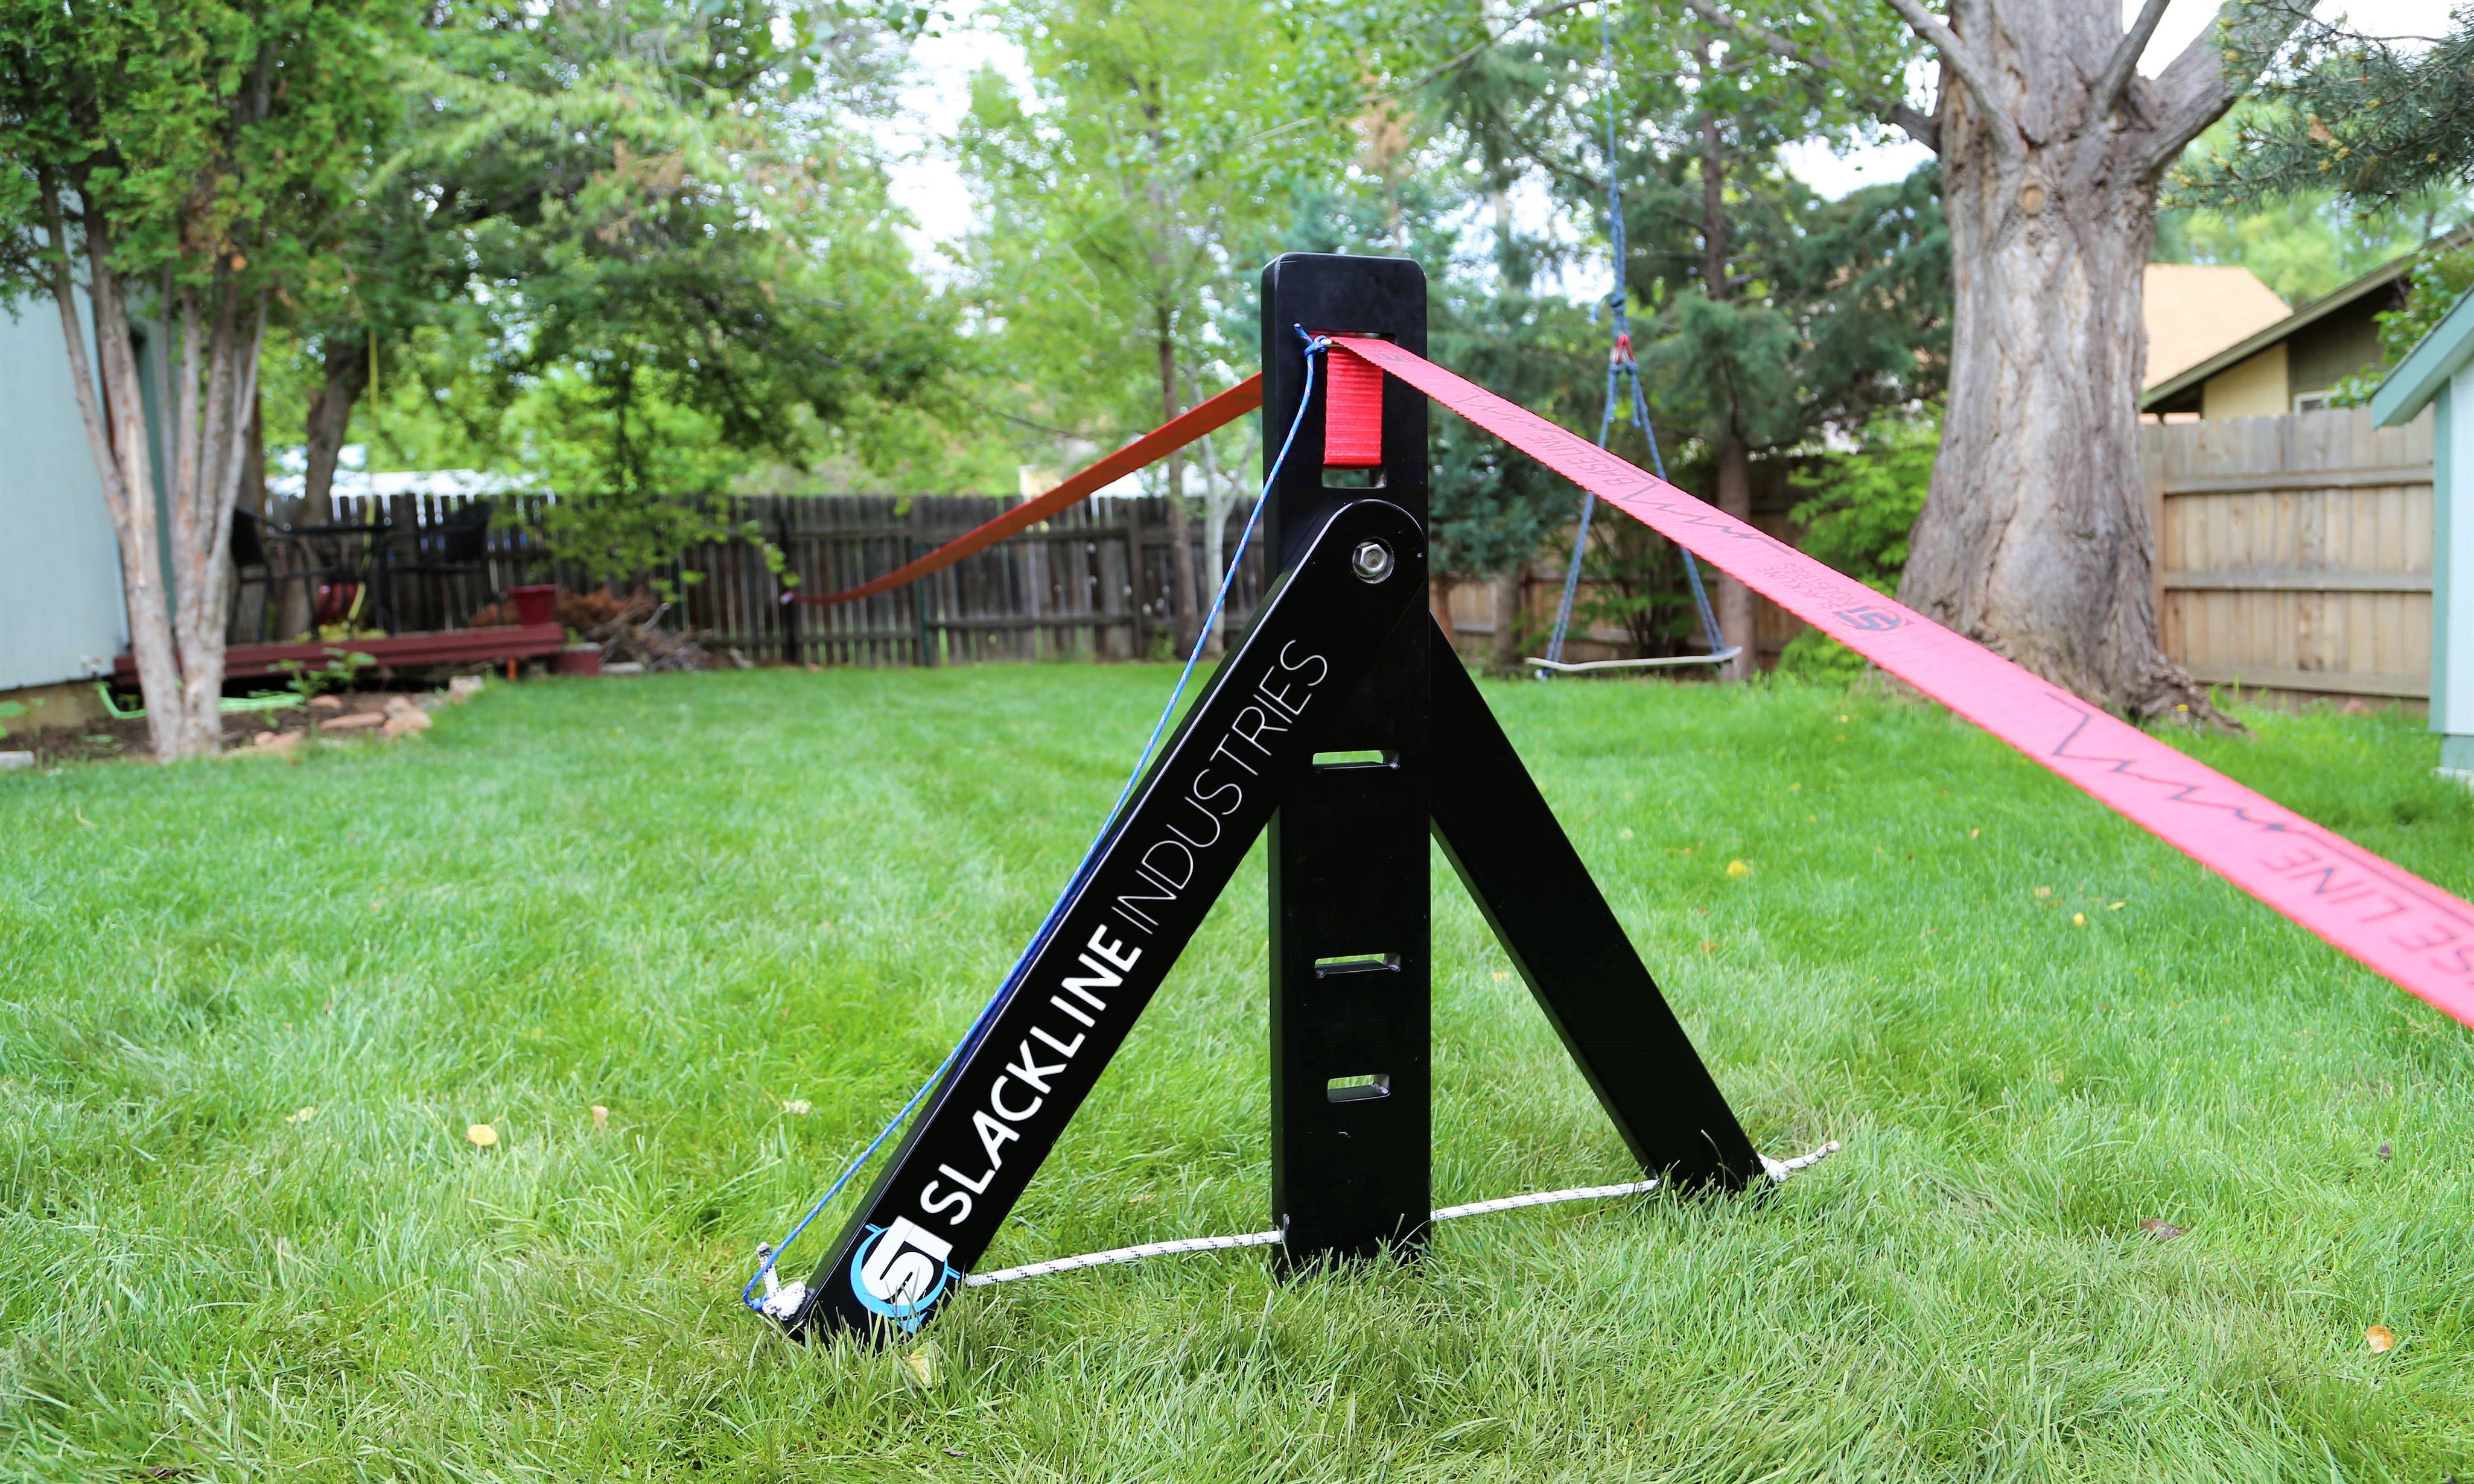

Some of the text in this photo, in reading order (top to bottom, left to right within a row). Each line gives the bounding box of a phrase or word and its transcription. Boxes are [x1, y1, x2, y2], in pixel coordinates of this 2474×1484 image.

[920, 638, 1329, 1225] SLACKLINE INDUSTRIES
[2257, 848, 2474, 988] SE LINE
